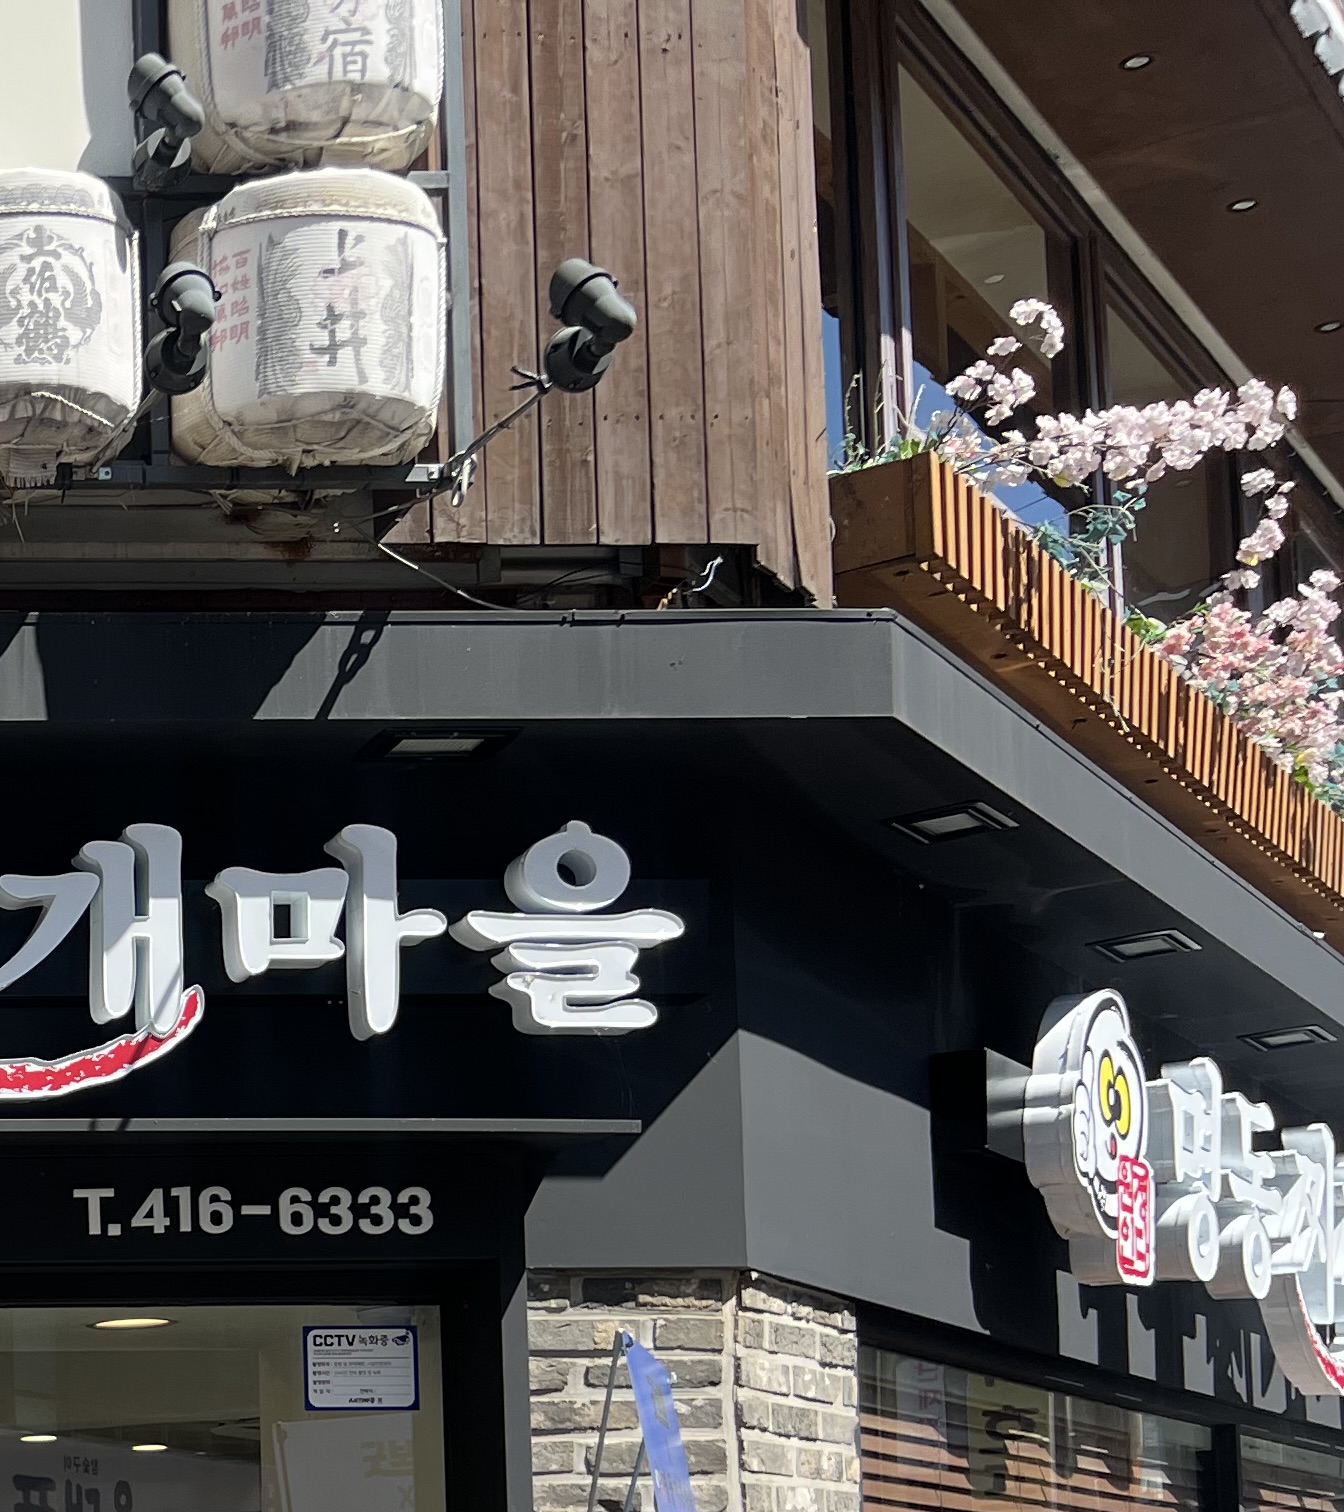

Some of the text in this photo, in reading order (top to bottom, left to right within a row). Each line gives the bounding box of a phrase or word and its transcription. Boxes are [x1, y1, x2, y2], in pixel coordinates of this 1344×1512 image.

[72, 1185, 435, 1237] T.416-6333
[313, 1334, 390, 1347] CCTV 녹화중
